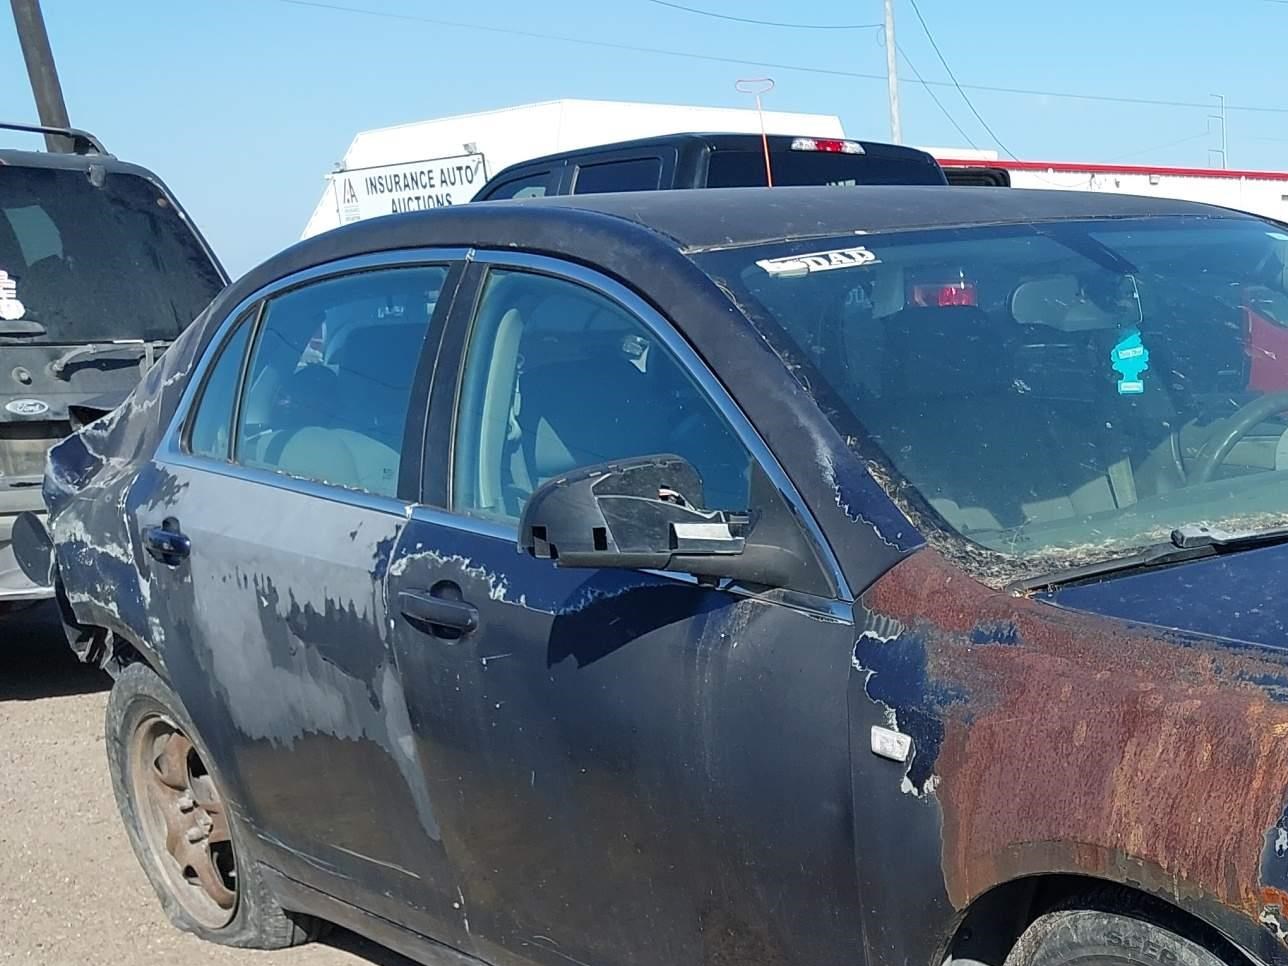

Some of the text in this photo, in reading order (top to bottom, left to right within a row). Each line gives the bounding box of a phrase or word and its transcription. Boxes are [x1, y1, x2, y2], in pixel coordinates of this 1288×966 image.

[365, 166, 474, 196] INSURANCE AUTO
[391, 193, 453, 213] AUCTIONS
